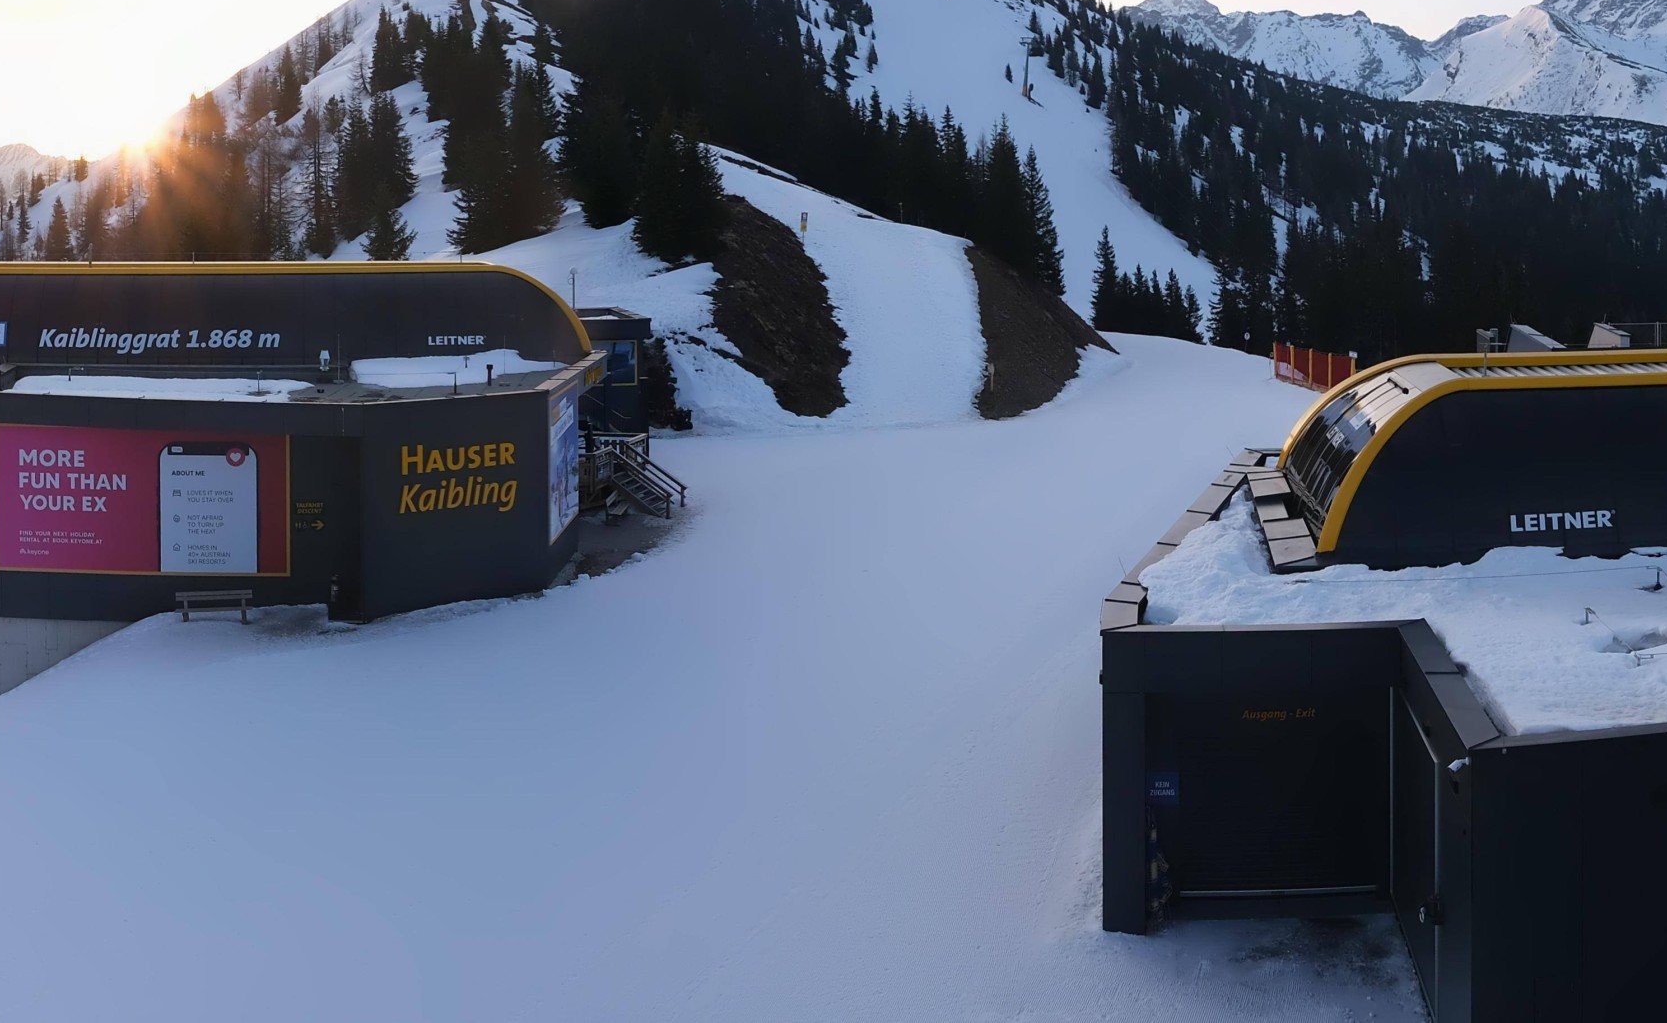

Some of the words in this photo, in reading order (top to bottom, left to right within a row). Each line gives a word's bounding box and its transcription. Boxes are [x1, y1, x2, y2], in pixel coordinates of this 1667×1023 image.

[39, 327, 180, 355] Kaiblinggrat
[186, 329, 252, 348] 1.868
[258, 333, 281, 348] m
[18, 448, 85, 467] MORE
[401, 442, 515, 475] HAUSER
[19, 472, 60, 489] FUN
[67, 473, 127, 490] THAN
[20, 494, 75, 511] YOUR
[82, 496, 107, 512] EX
[400, 476, 517, 514] Kaibling
[1242, 709, 1287, 721] Ausgang
[1296, 707, 1316, 717] Exit
